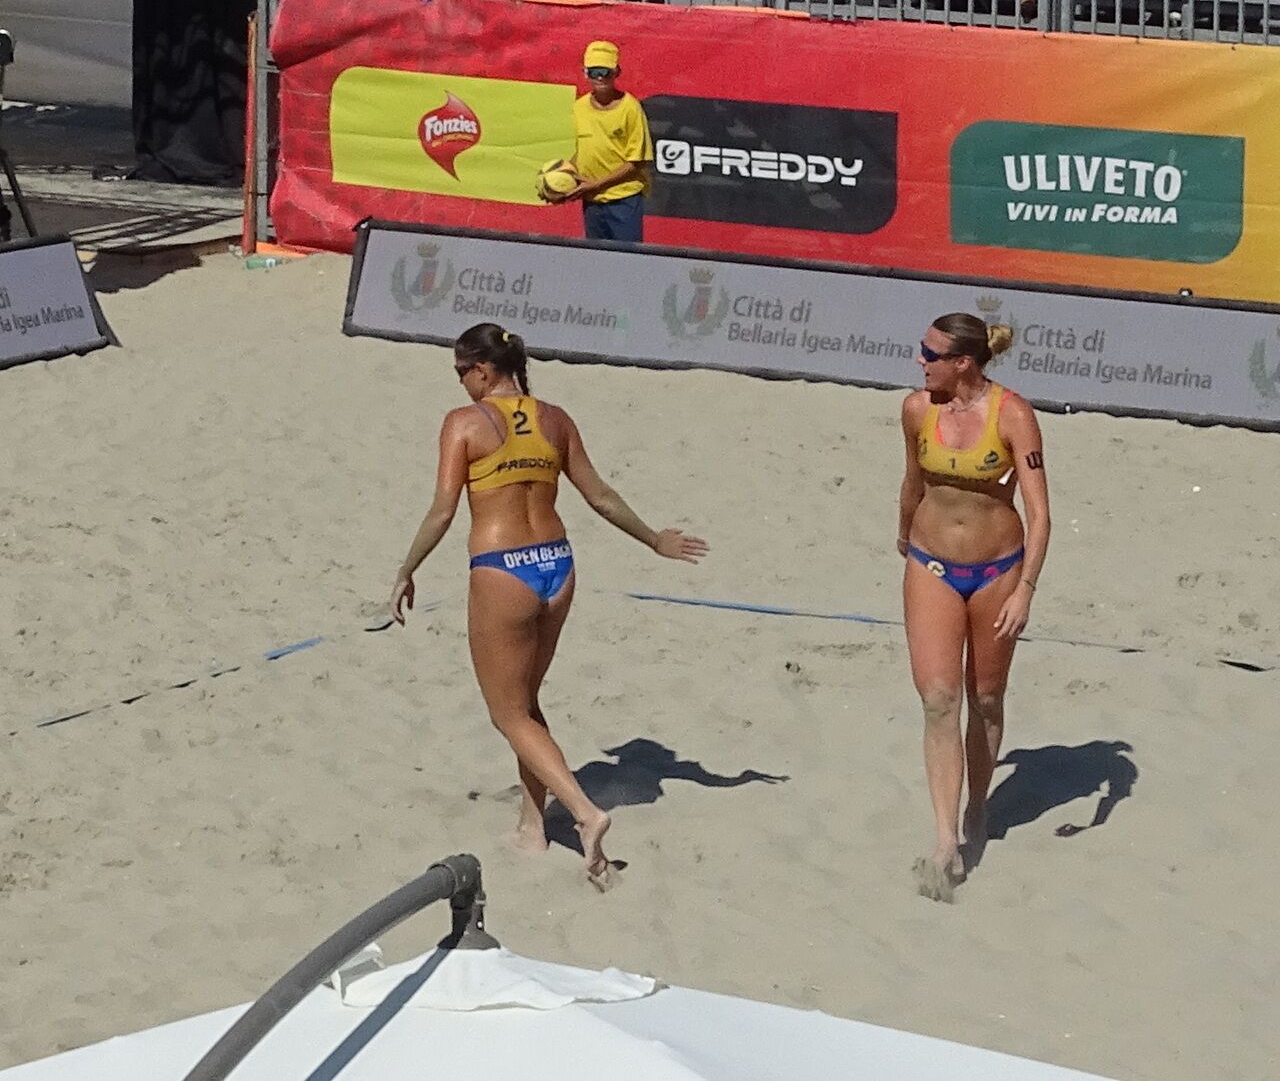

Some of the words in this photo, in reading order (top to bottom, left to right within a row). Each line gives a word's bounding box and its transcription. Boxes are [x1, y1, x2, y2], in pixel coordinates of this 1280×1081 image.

[424, 114, 478, 142] Fonzies
[692, 145, 864, 188] FREDDY
[1003, 154, 1182, 202] ULIVETO
[1006, 202, 1059, 222] VIVI
[1064, 207, 1087, 222] IN
[1091, 203, 1178, 224] FORMA
[457, 268, 506, 294] Città
[511, 273, 533, 296] di
[41, 304, 85, 326] Marina
[452, 294, 519, 320] Bellaria
[522, 300, 562, 325] Igea
[732, 295, 783, 321] Città
[790, 300, 812, 323] di
[728, 323, 796, 348] Bellaria
[801, 329, 843, 355] Igea
[846, 334, 914, 360] Marina
[1023, 324, 1076, 351] Città
[1082, 328, 1106, 354] di
[1017, 351, 1092, 378] Bellaria
[1095, 359, 1138, 385] Igea
[1141, 364, 1213, 391] Marina
[512, 410, 532, 435] 2
[503, 547, 540, 569] OPEN
